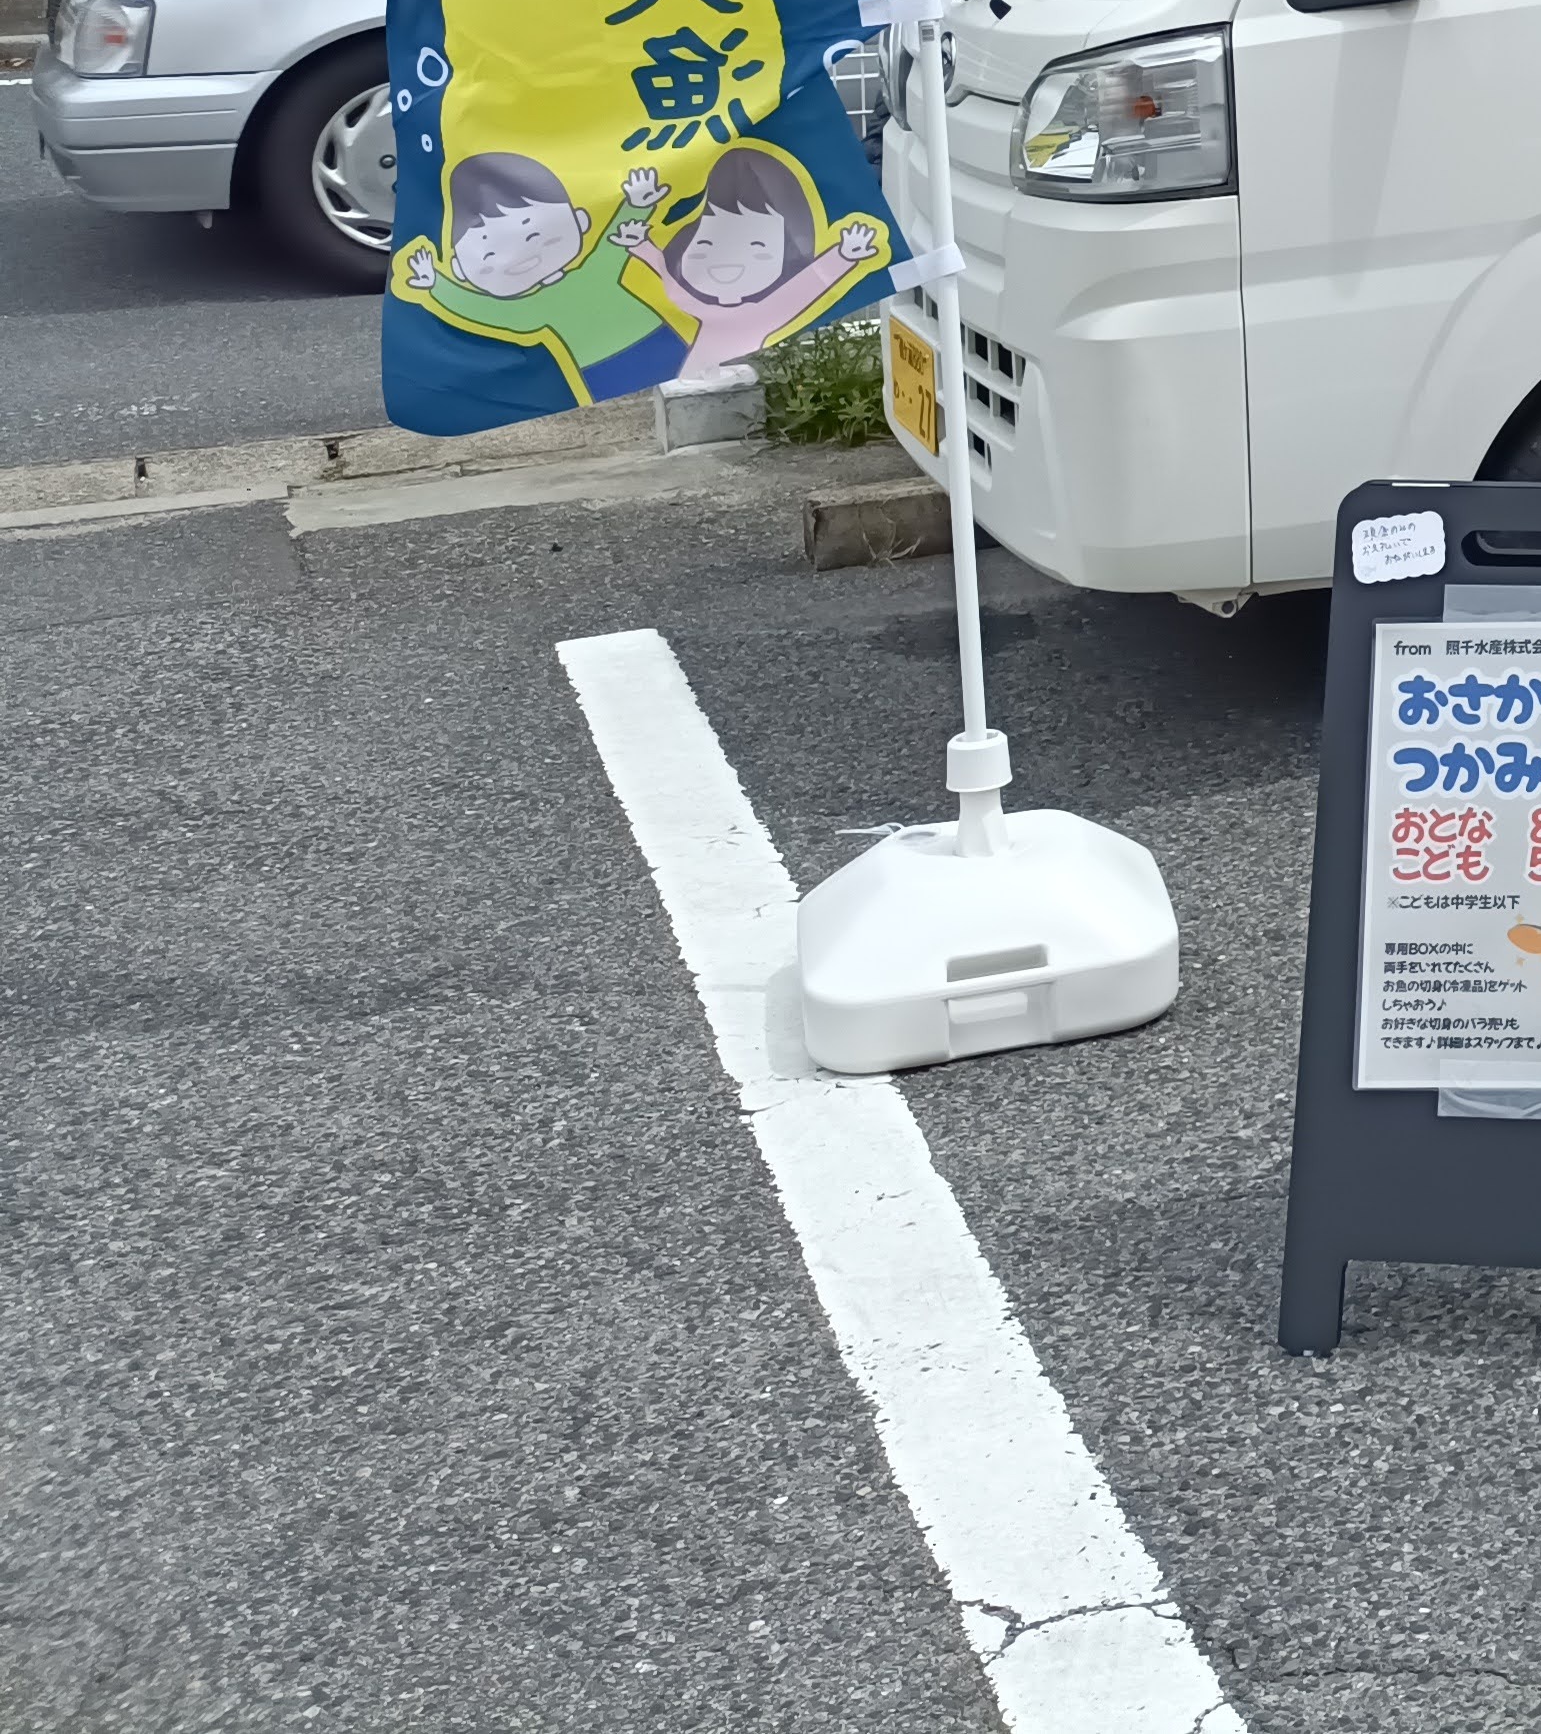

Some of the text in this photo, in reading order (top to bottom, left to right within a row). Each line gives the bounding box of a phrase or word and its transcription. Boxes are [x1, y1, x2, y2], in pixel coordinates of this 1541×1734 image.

[1393, 640, 1432, 656] from
[1392, 807, 1493, 844] おとな
[1392, 844, 1490, 881] こども
[1387, 894, 1520, 910] ※こどもは中学生以下
[1384, 942, 1473, 956] 専用BOXの中に
[1383, 961, 1495, 974] 両手をいれてたくさん
[1381, 1017, 1521, 1031] お好きな切身のバラ売りも
